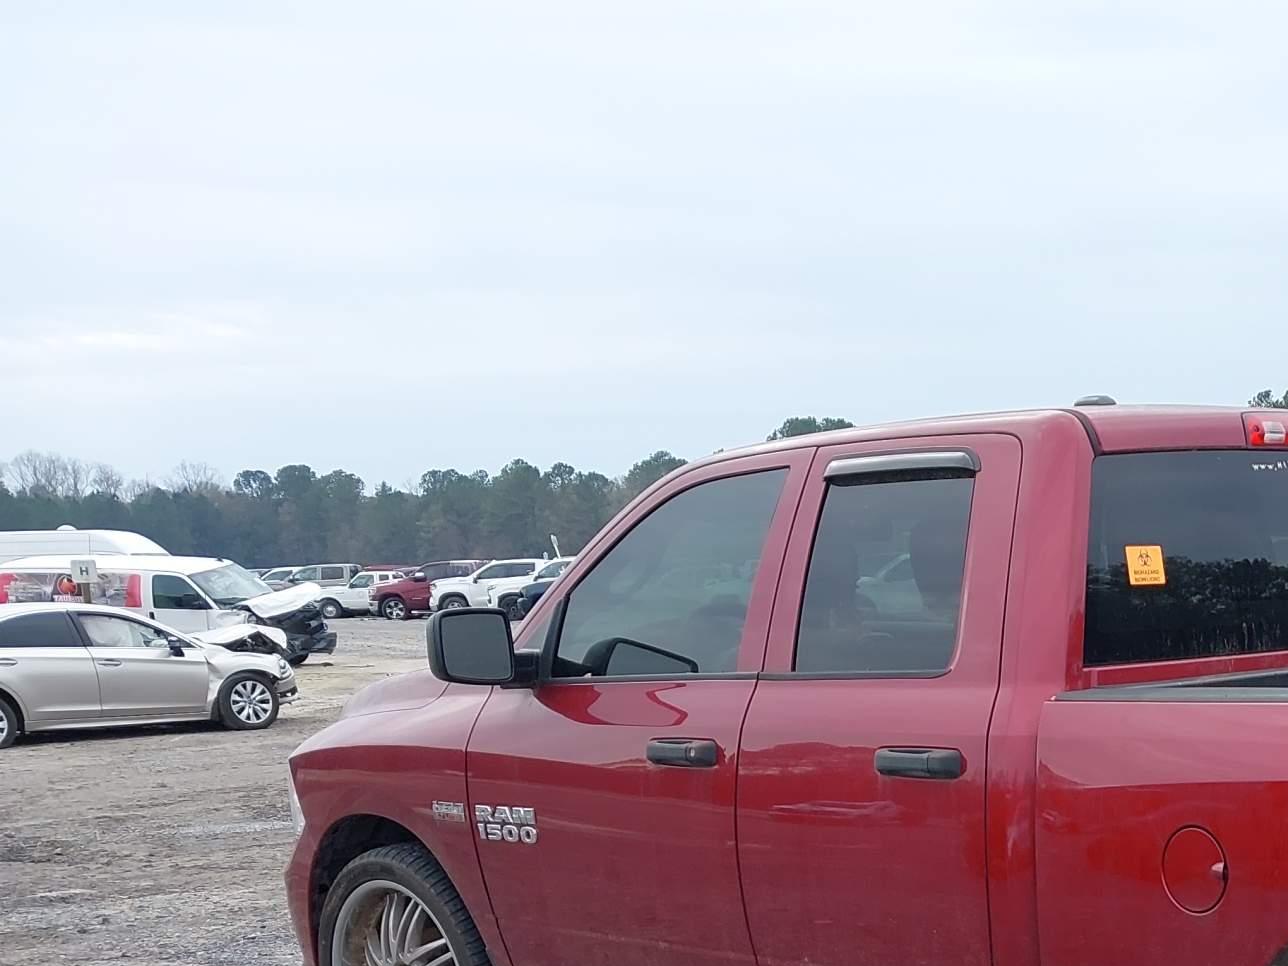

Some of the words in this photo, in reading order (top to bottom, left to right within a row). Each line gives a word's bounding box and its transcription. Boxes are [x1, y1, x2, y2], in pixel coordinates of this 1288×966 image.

[79, 566, 89, 576] H
[474, 804, 537, 825] RAM
[477, 823, 537, 844] 1500
